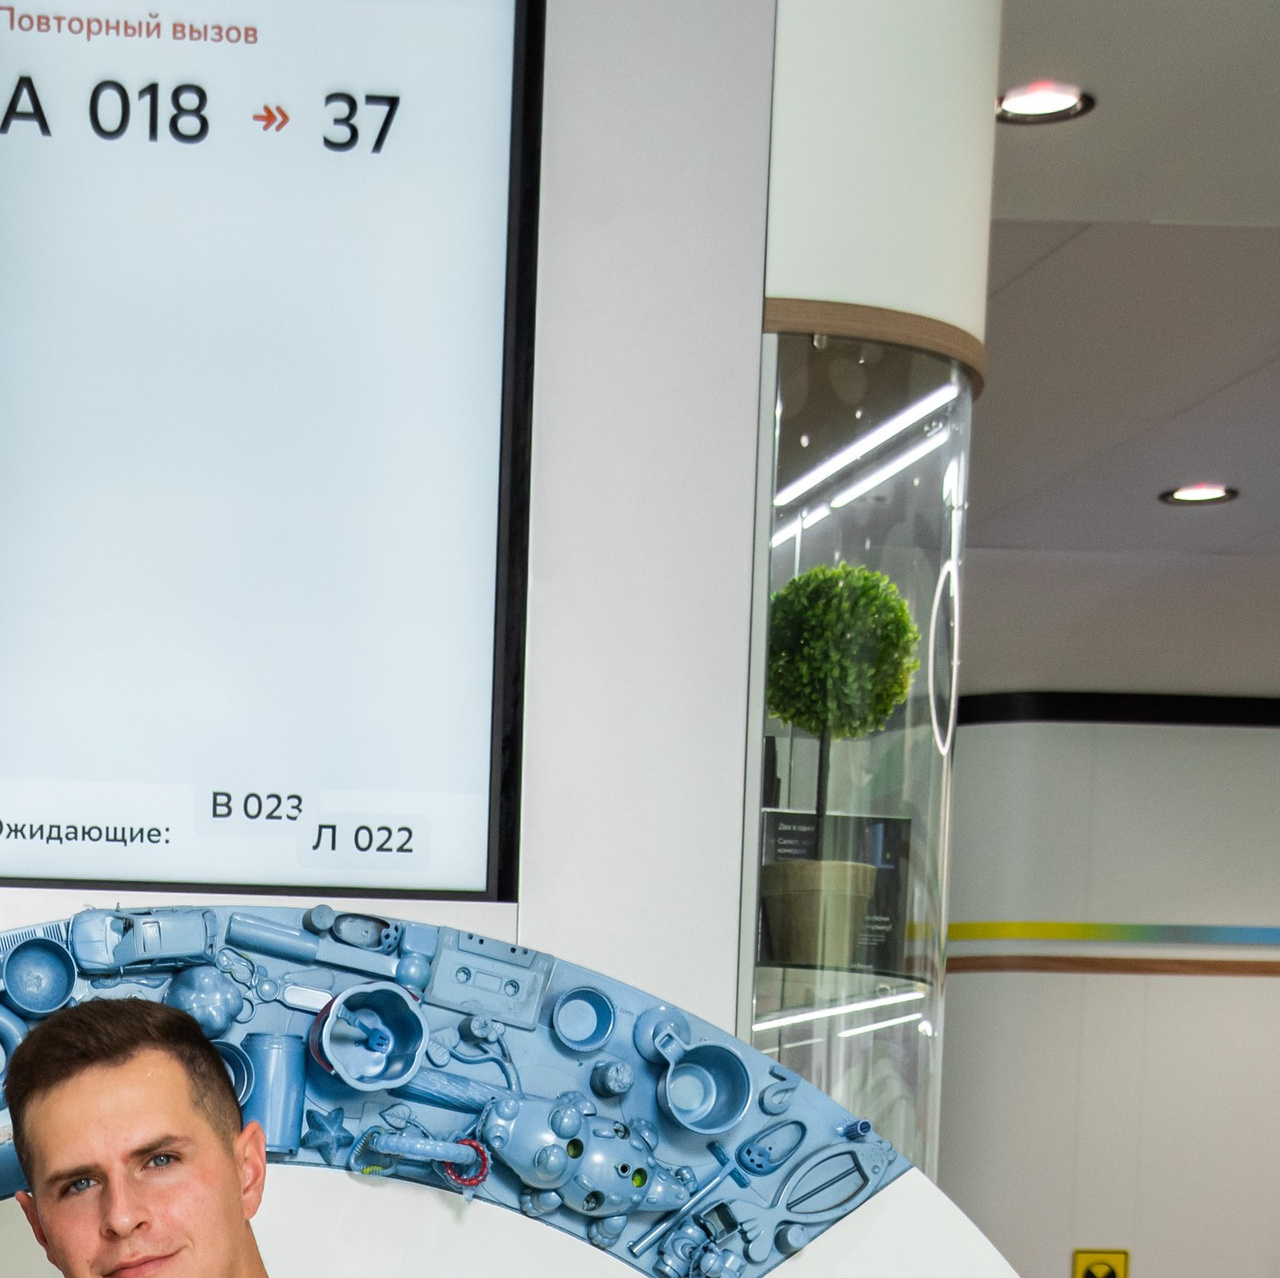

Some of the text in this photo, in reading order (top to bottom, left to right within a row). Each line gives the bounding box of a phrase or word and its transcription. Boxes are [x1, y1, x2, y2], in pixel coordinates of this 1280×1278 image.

[172, 22, 259, 45] вызов
[88, 79, 210, 144] 018
[322, 91, 401, 154] 37
[211, 791, 304, 820] В 023
[312, 824, 414, 853] Л 022
